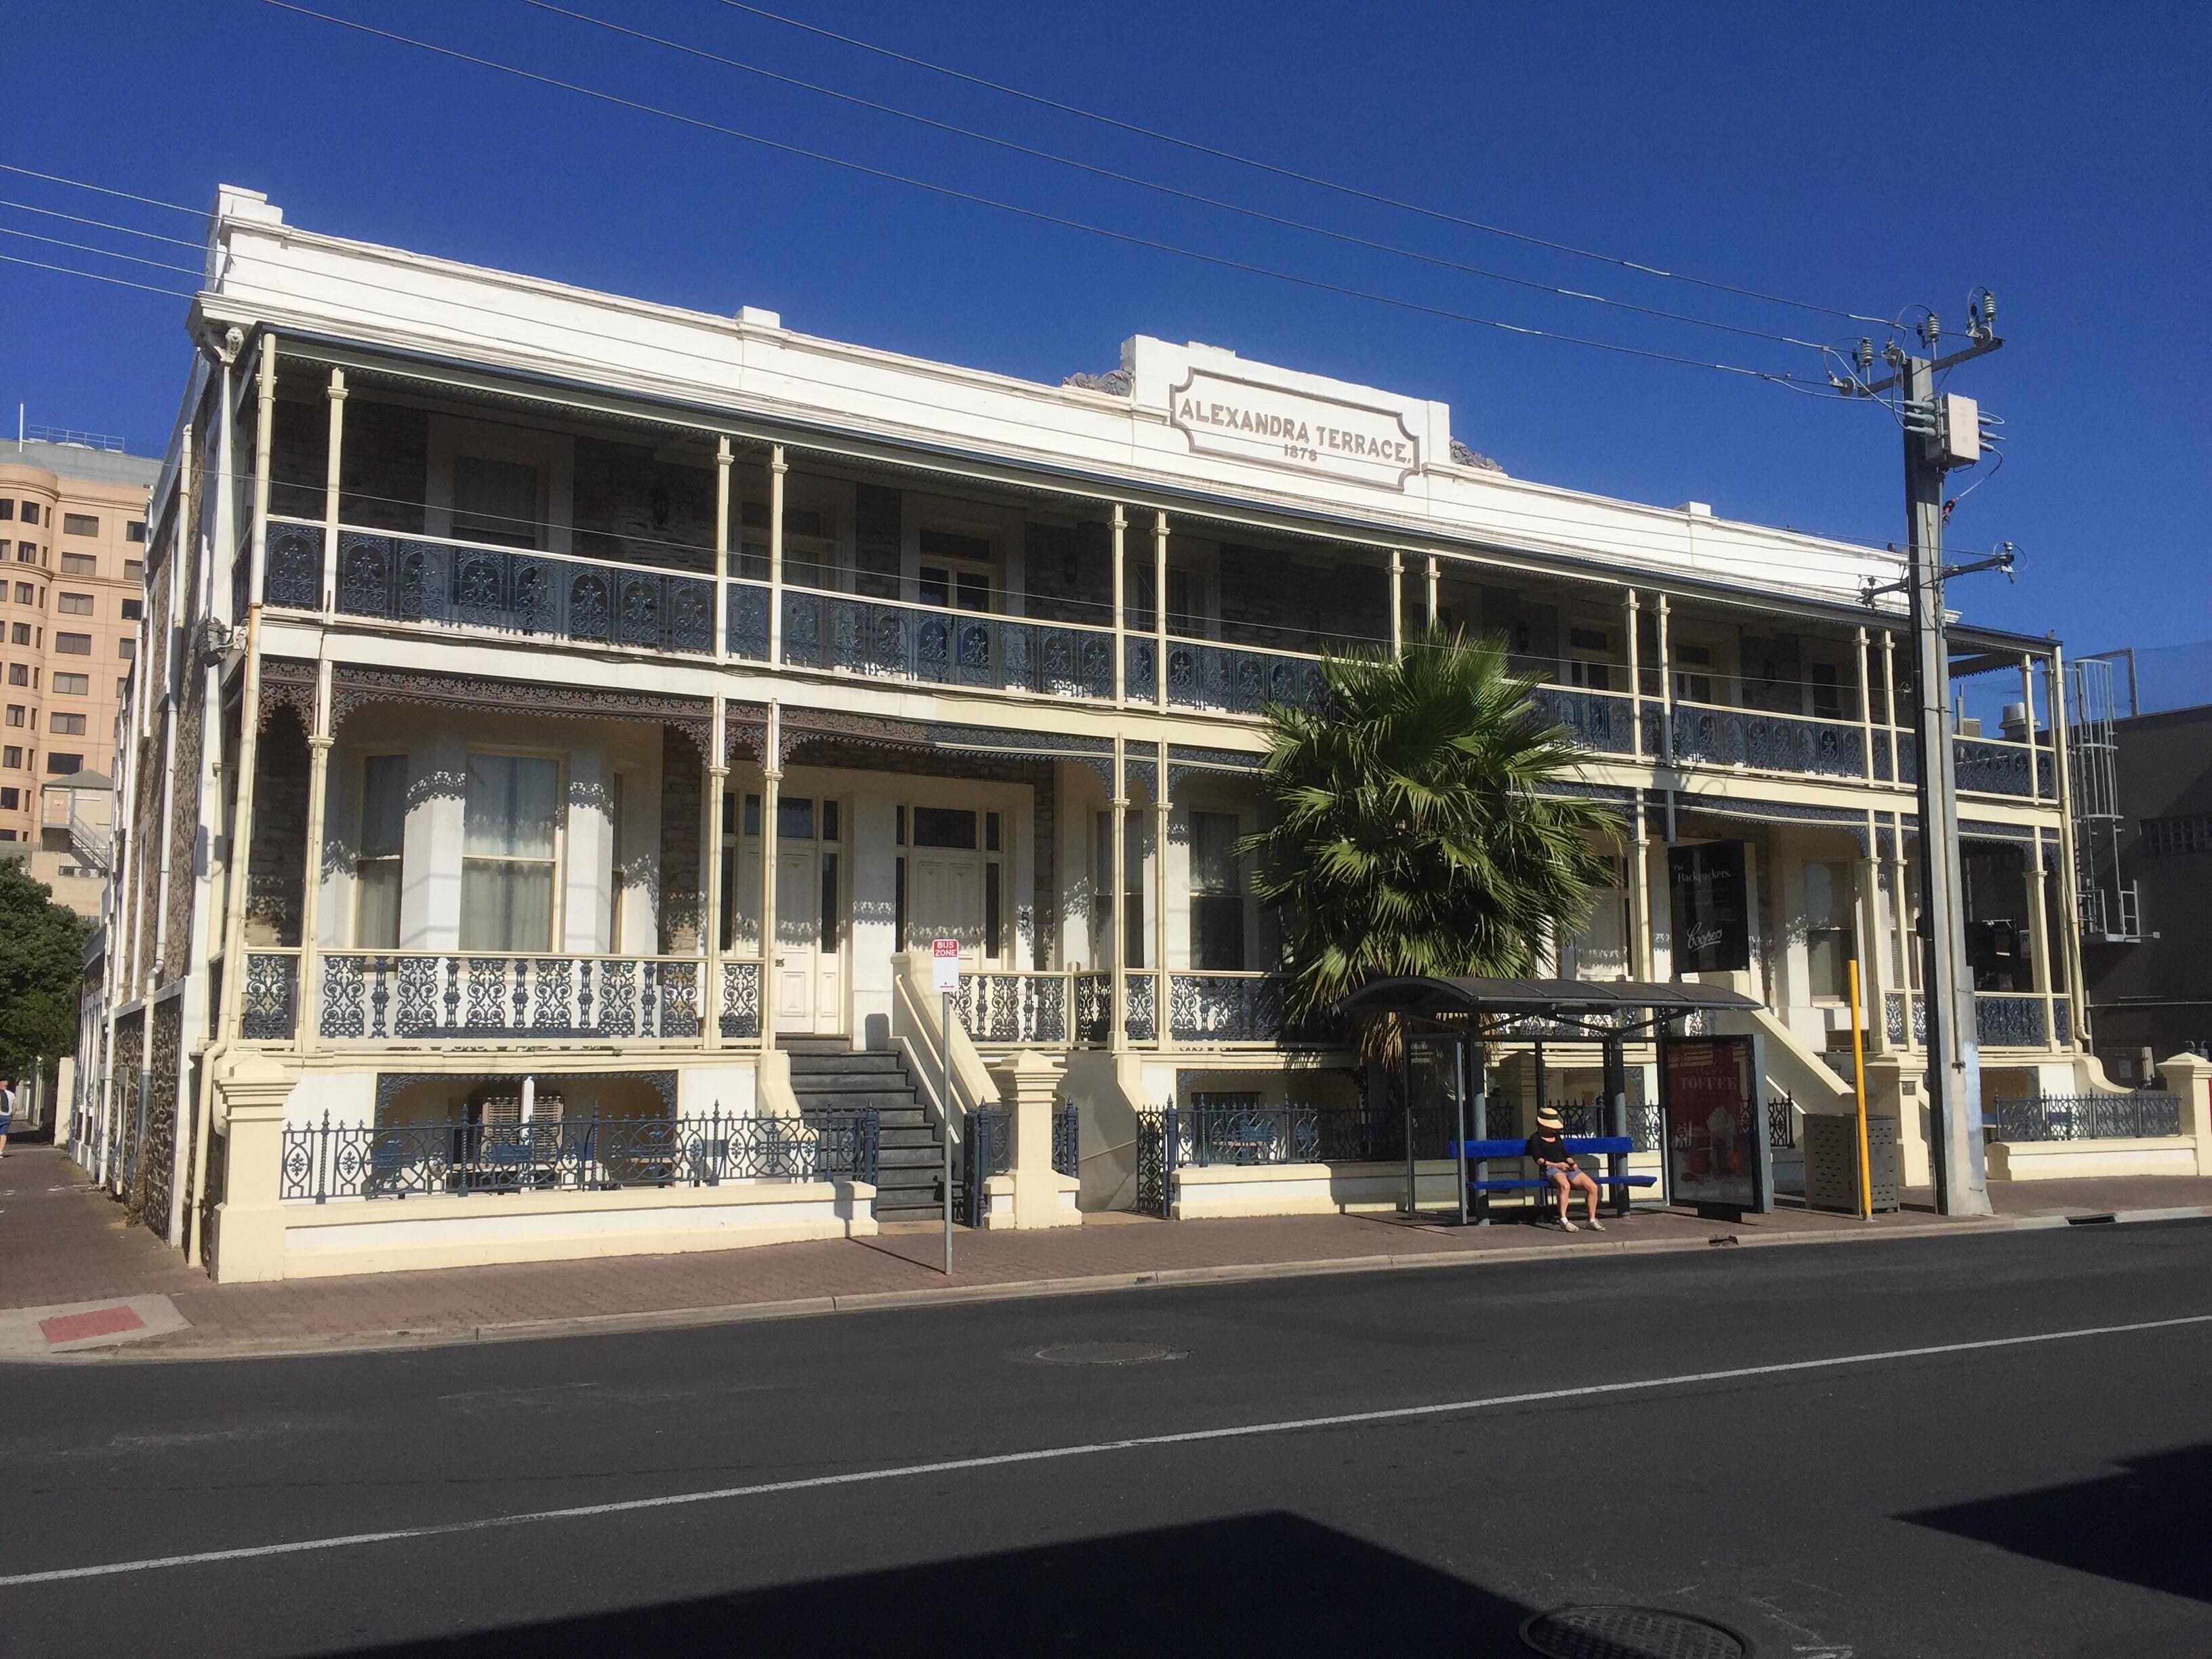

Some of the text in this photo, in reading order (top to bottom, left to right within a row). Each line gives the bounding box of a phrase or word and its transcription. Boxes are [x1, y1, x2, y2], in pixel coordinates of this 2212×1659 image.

[1179, 398, 1310, 445] ALEXANDRA
[1284, 444, 1318, 462] 1878
[1021, 911, 1030, 928] 5
[1680, 1076, 1737, 1090] TOFFEE
